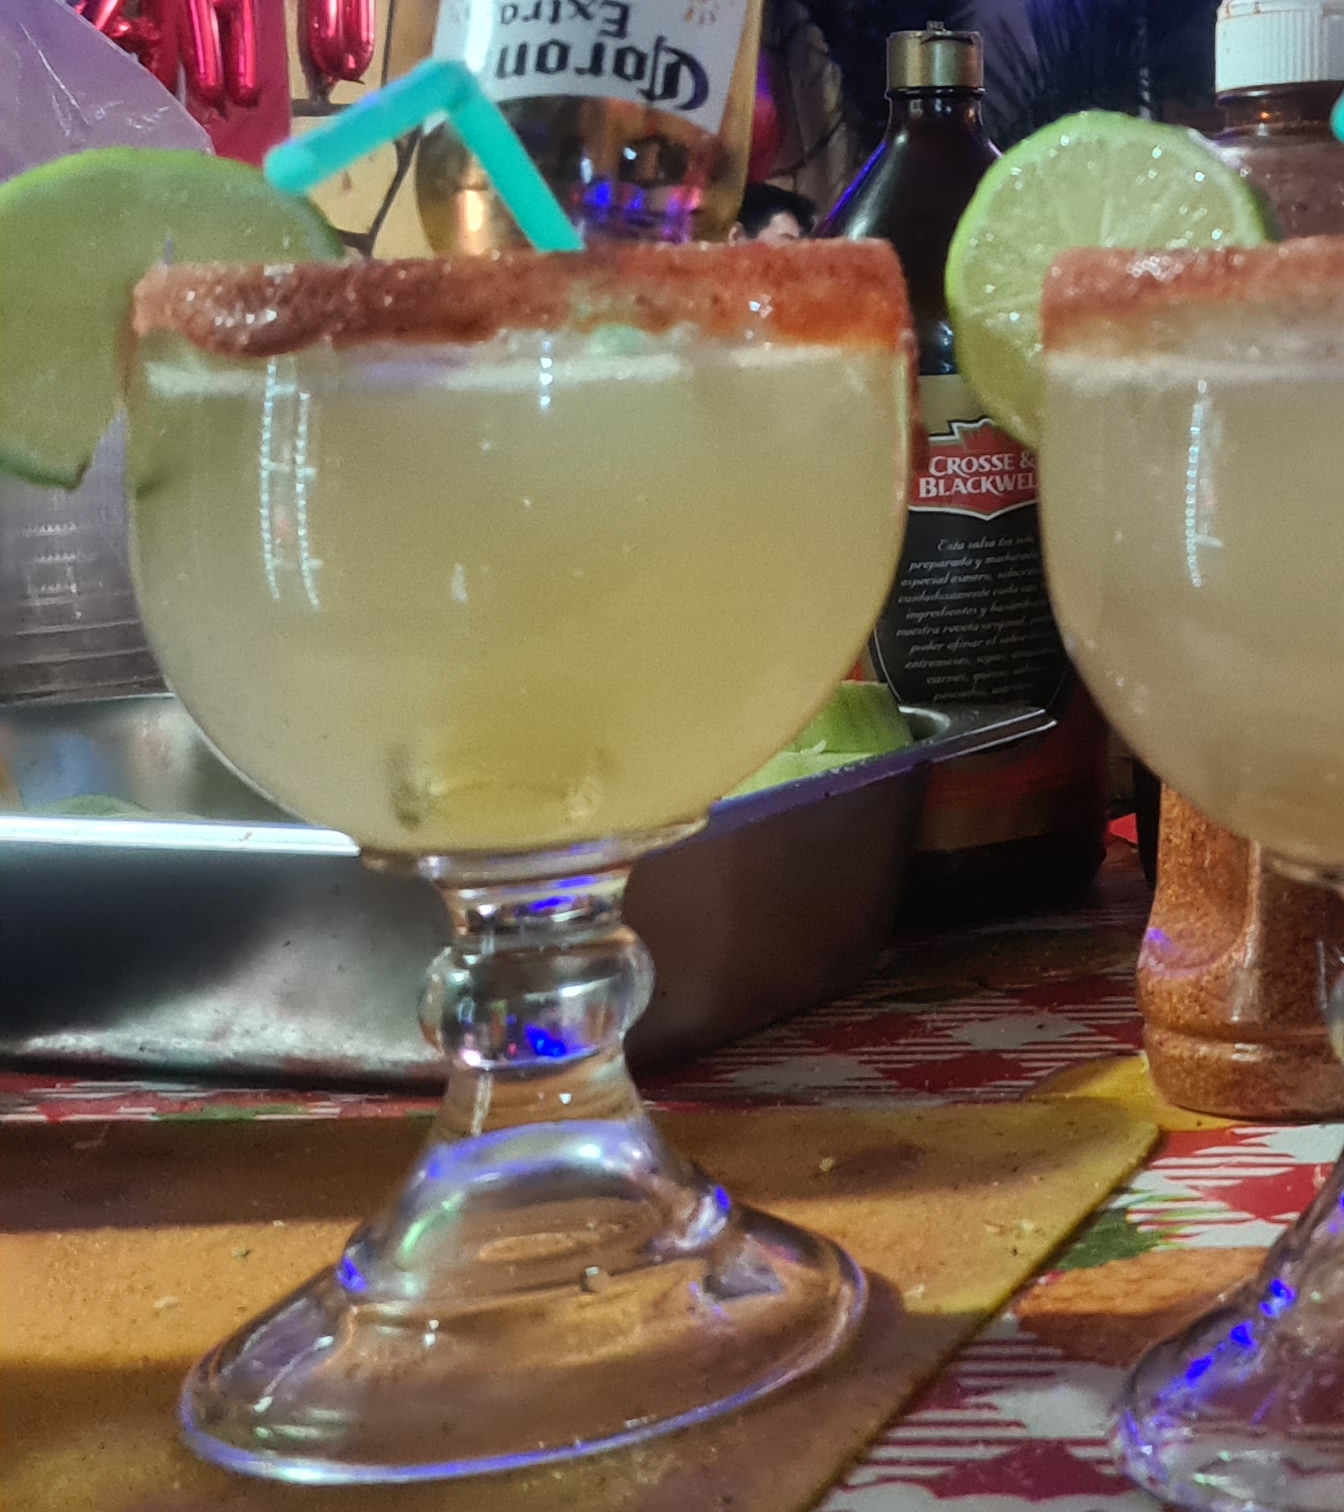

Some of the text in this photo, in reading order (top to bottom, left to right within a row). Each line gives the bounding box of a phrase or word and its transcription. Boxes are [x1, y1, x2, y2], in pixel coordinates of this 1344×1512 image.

[495, 34, 710, 111] Coron
[928, 453, 1014, 477] CROSSE
[918, 471, 1037, 499] BLACKWEL
